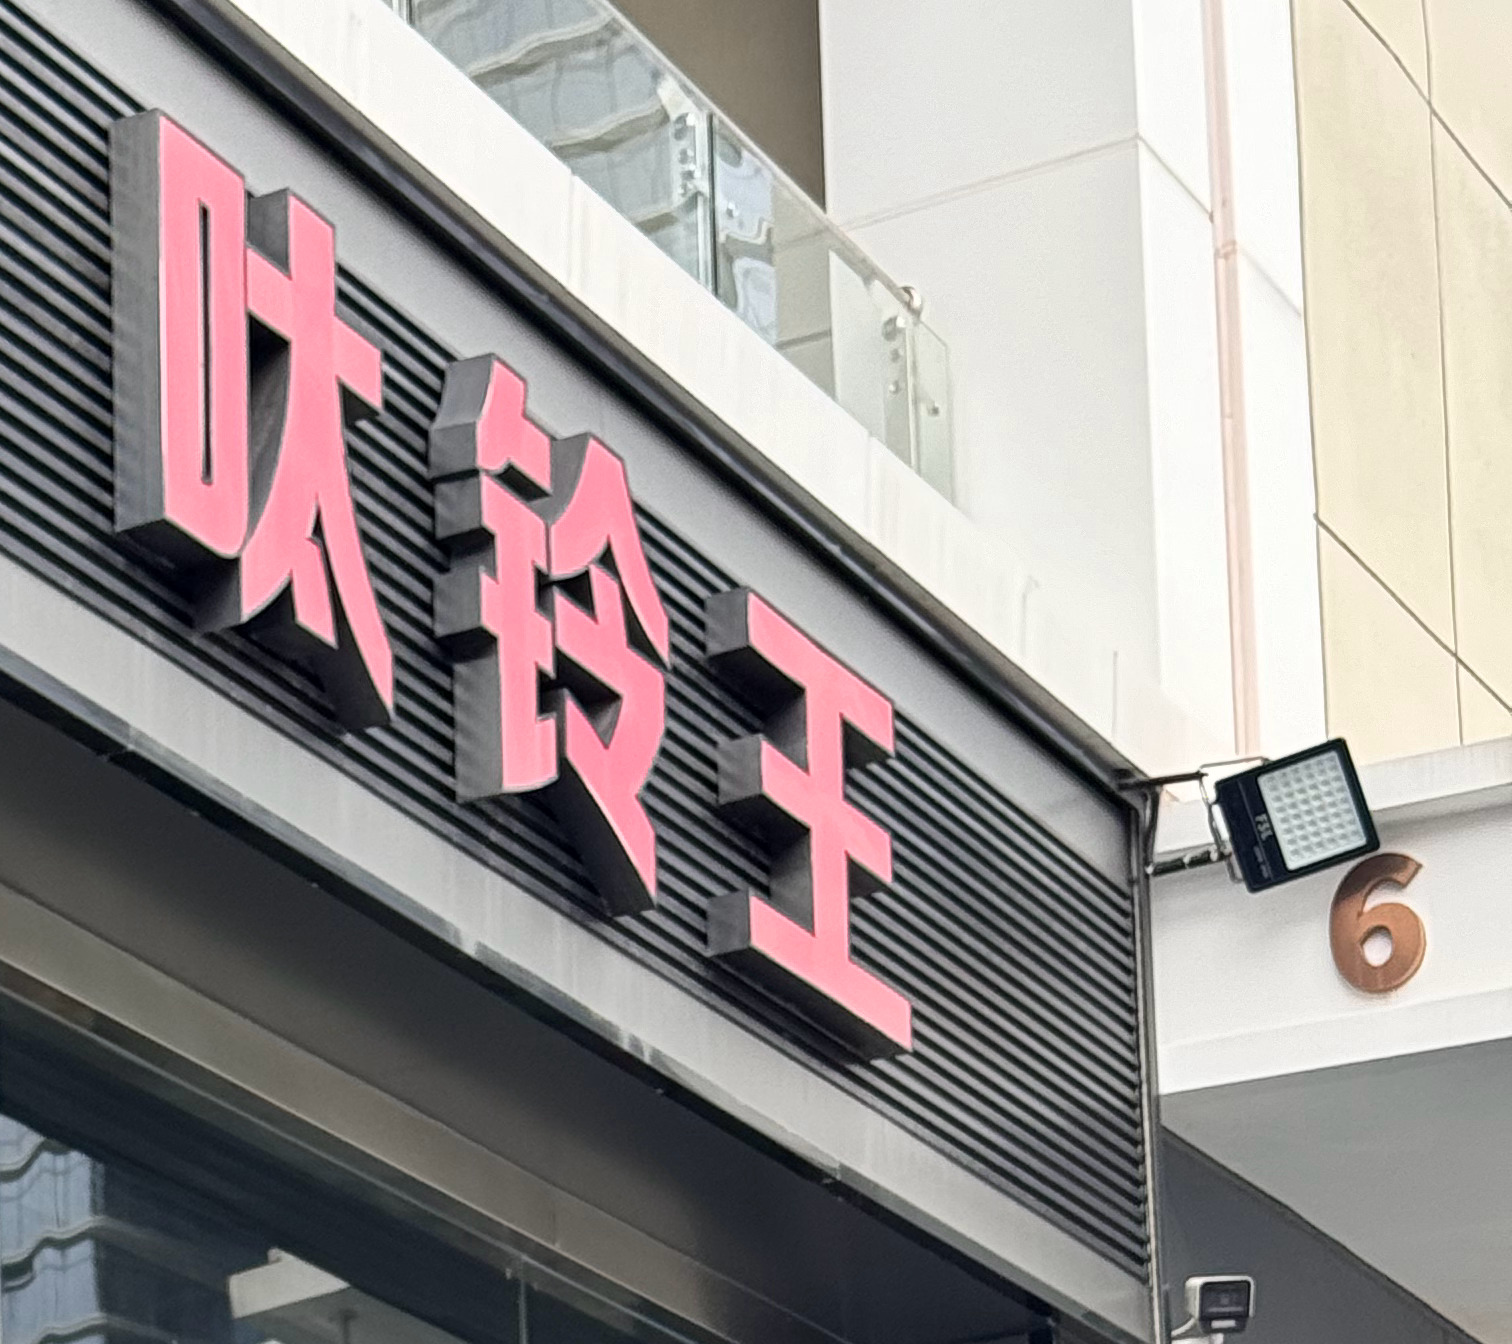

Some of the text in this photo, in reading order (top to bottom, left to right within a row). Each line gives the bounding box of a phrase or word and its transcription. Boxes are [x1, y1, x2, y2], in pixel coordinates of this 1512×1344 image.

[128, 110, 912, 1055] 呔铃王
[1329, 852, 1426, 994] 6
